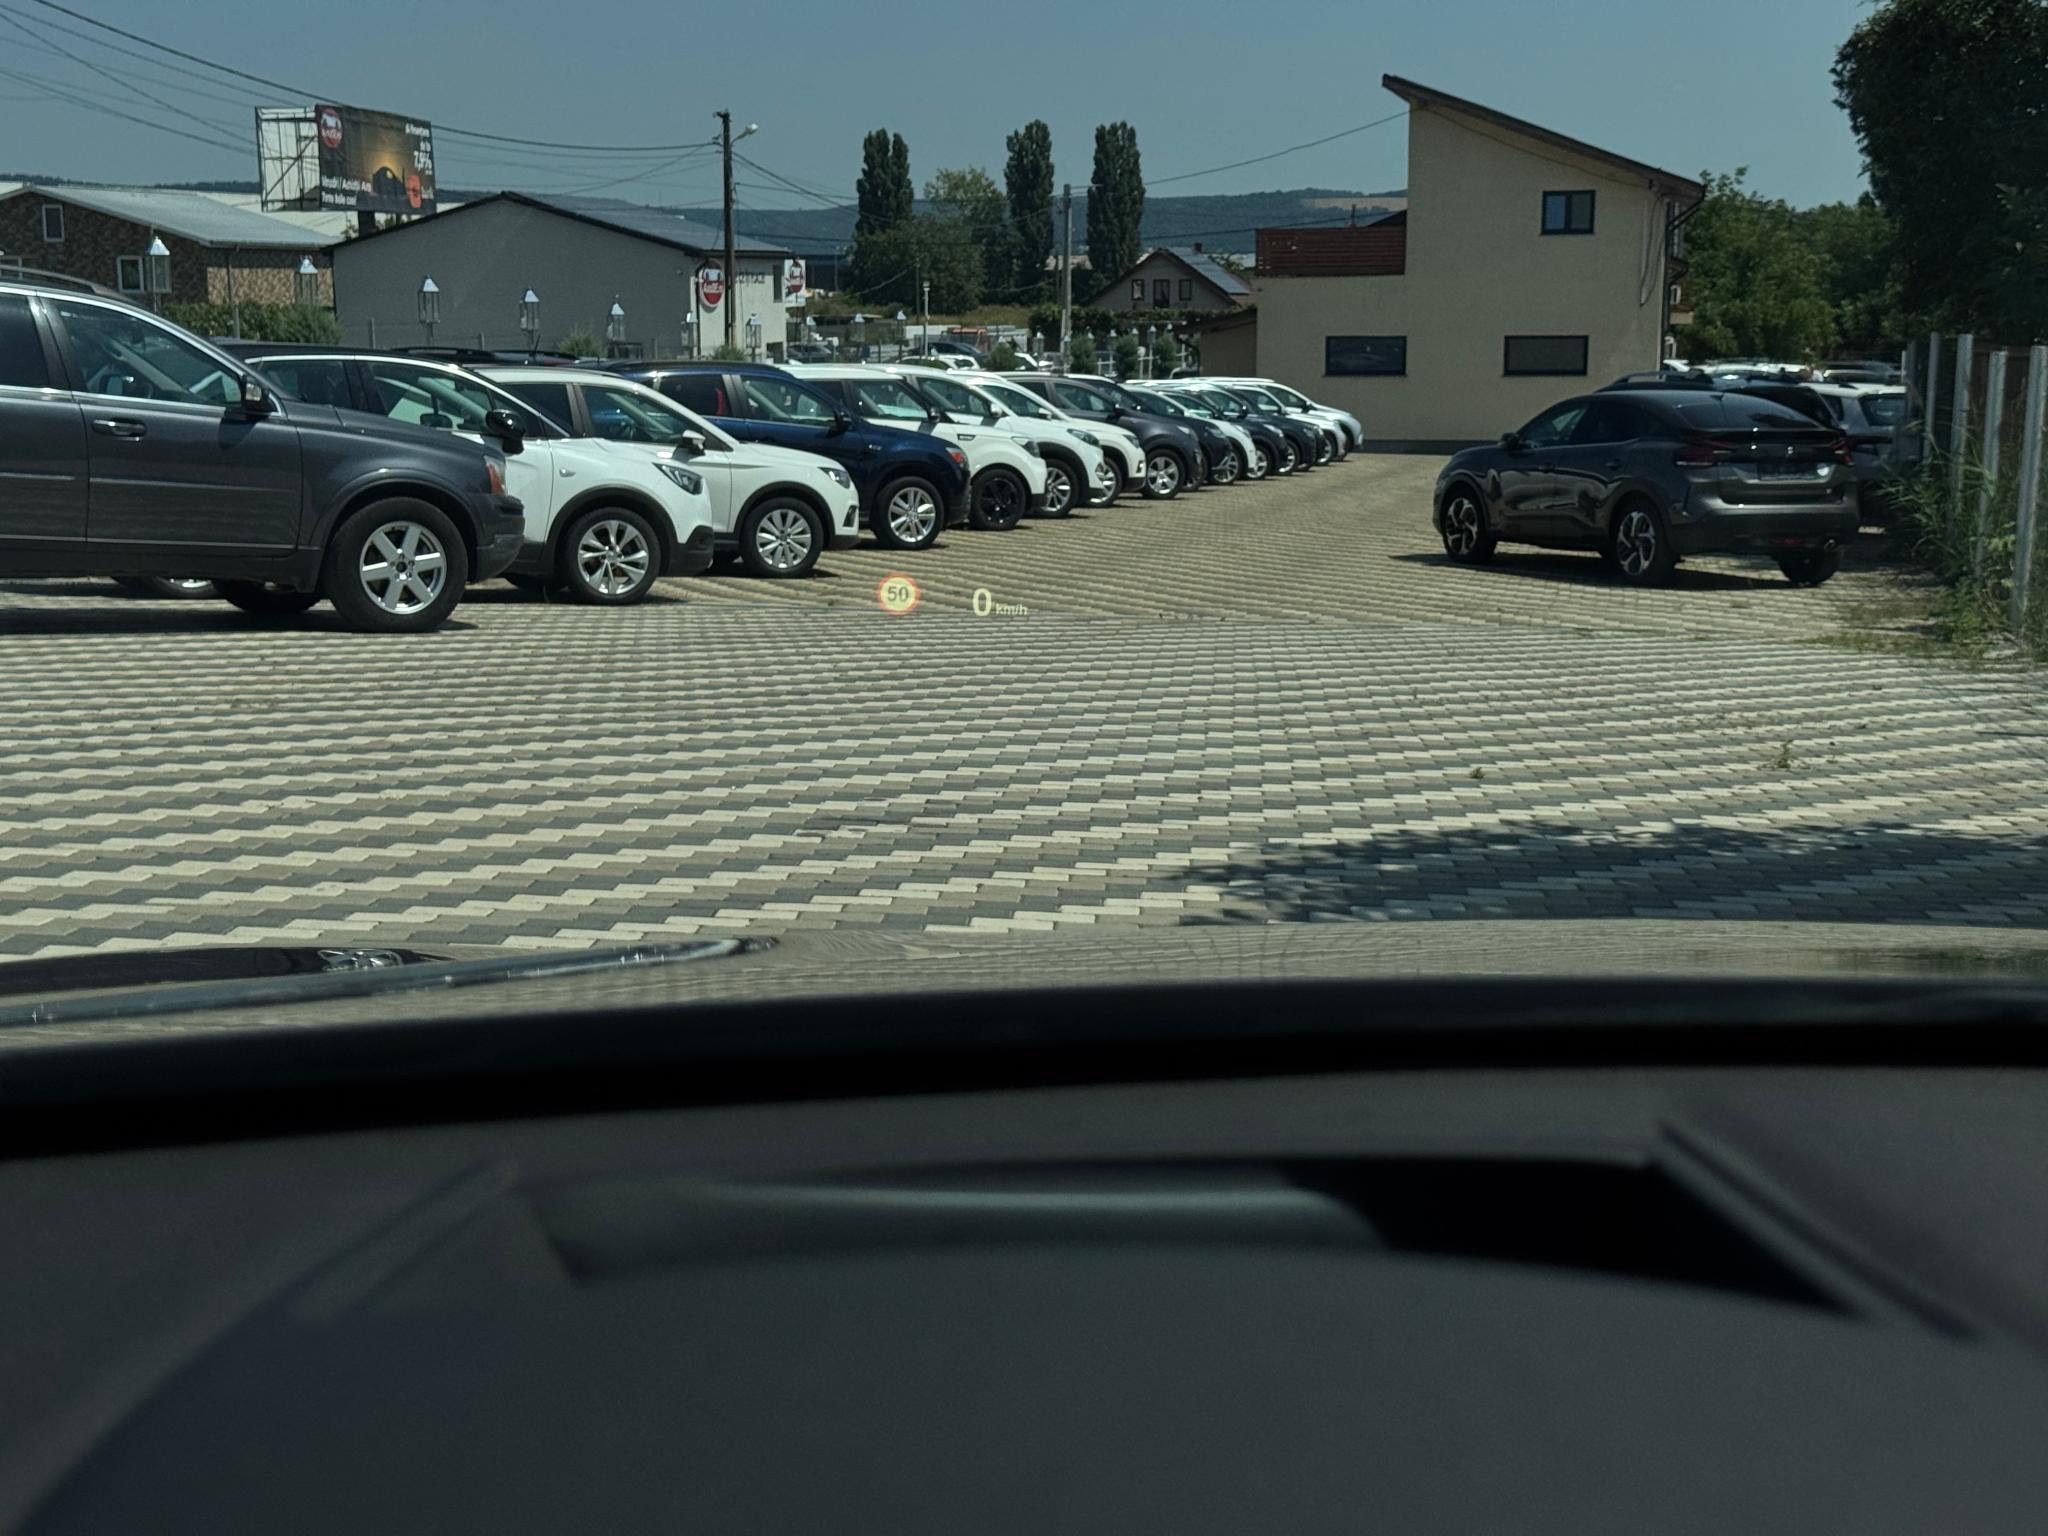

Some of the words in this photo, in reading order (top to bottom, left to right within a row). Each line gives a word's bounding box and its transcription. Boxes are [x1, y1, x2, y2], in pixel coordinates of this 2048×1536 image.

[887, 586, 909, 602] 50
[973, 588, 992, 617] 0
[995, 603, 1029, 616] km/h
